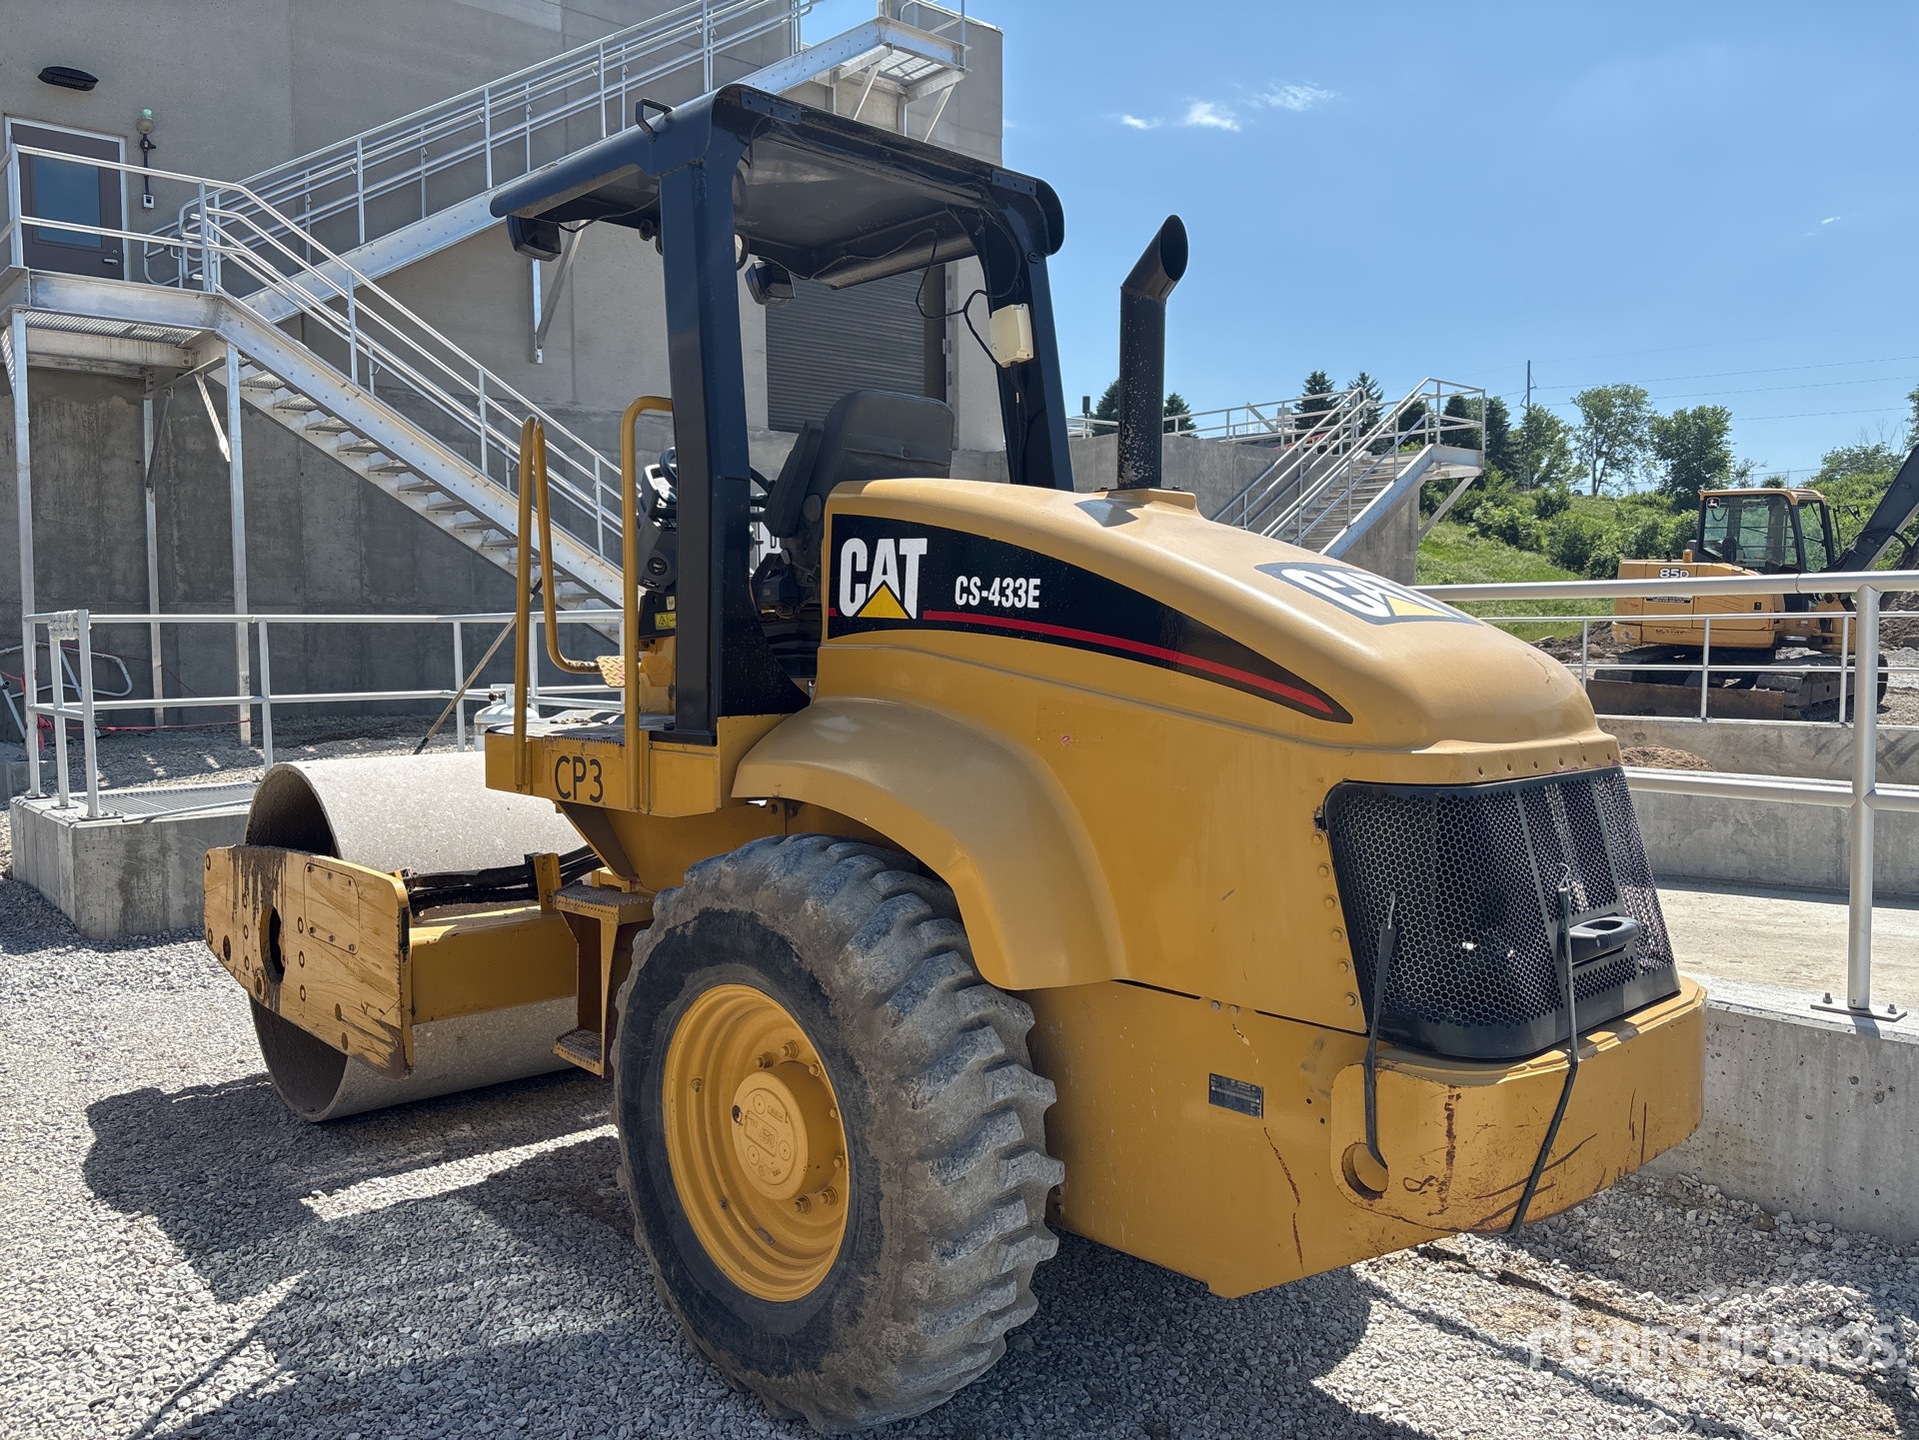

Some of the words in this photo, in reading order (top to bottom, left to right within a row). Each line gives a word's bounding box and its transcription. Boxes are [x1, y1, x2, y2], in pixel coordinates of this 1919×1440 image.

[839, 538, 928, 620] CAT
[955, 575, 1041, 609] CS-433E
[1280, 568, 1462, 619] CAT
[1659, 568, 1690, 579] 85D
[554, 755, 604, 803] CP3
